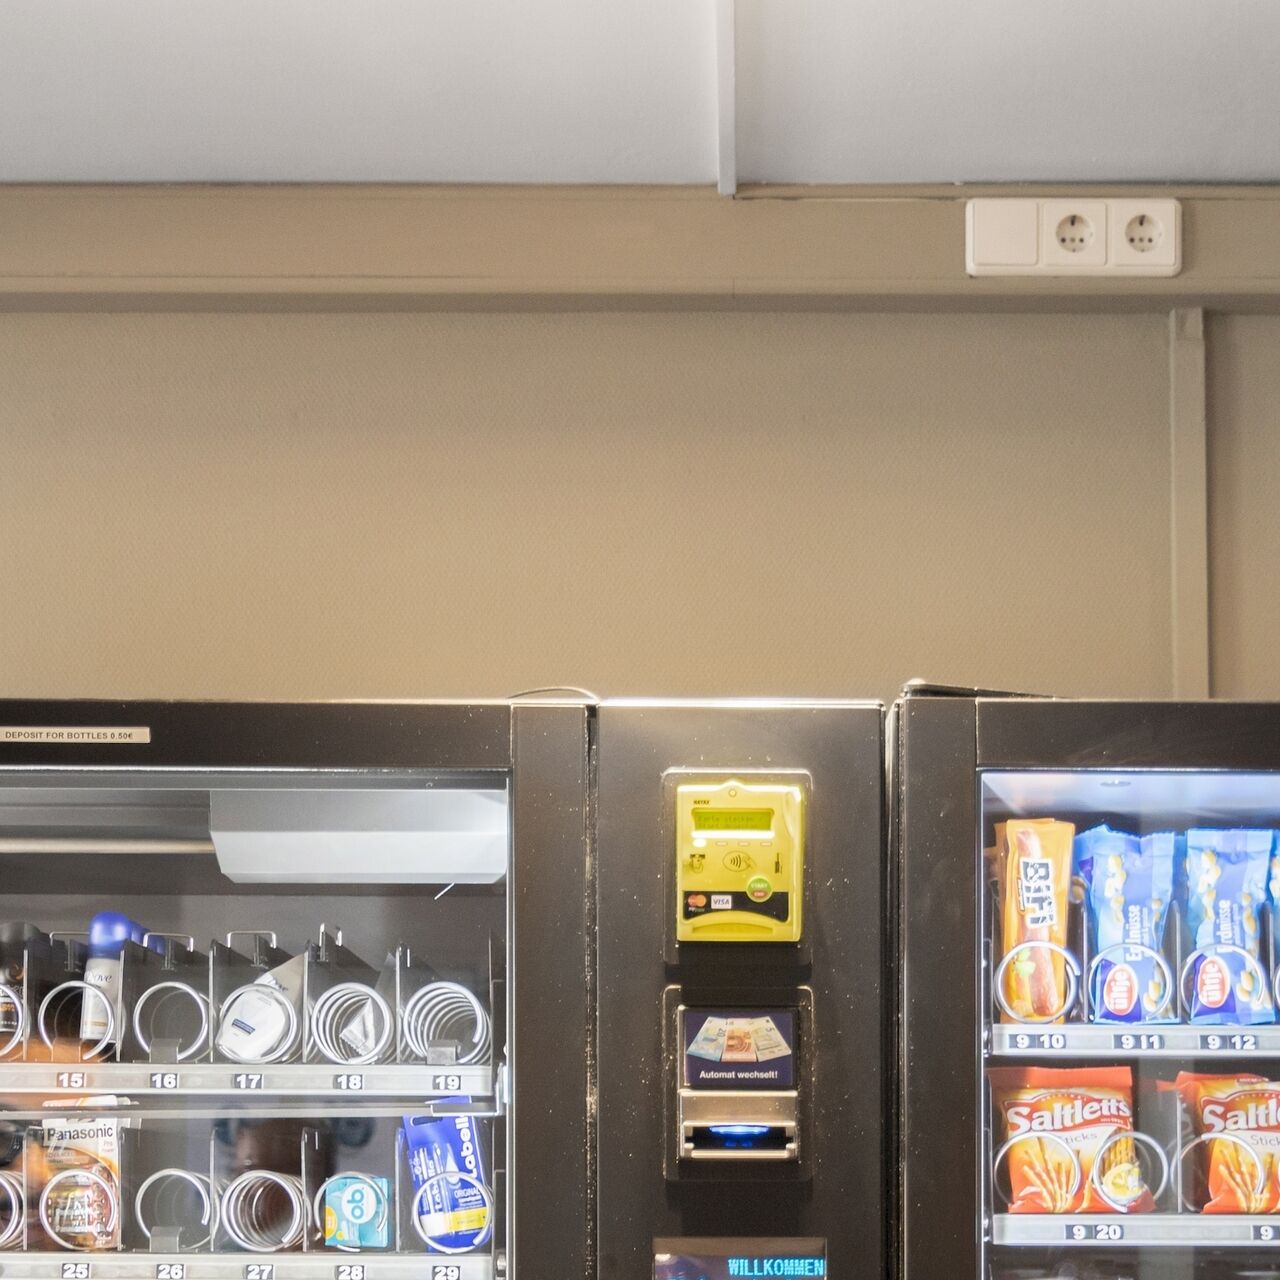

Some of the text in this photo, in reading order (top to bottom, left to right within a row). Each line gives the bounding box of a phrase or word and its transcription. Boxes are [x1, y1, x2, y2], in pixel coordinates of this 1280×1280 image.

[67, 732, 108, 740] BOTTLES
[713, 898, 730, 906] VISA
[59, 1074, 82, 1088] 15
[152, 1074, 176, 1088] 16
[237, 1075, 260, 1088] 17
[699, 1070, 778, 1079] Automat wechselt!
[338, 1075, 362, 1089] 18
[436, 1076, 460, 1089] 19
[1007, 1099, 1131, 1134] Saltletts
[47, 1124, 114, 1140] Panasonic
[455, 1115, 478, 1179] Labell
[64, 1264, 88, 1278] 25
[158, 1265, 183, 1279] 26
[248, 1265, 272, 1279] 27
[340, 1266, 364, 1280] 28
[434, 1266, 459, 1280] 29
[728, 1258, 824, 1276] WILLKOMMEN
